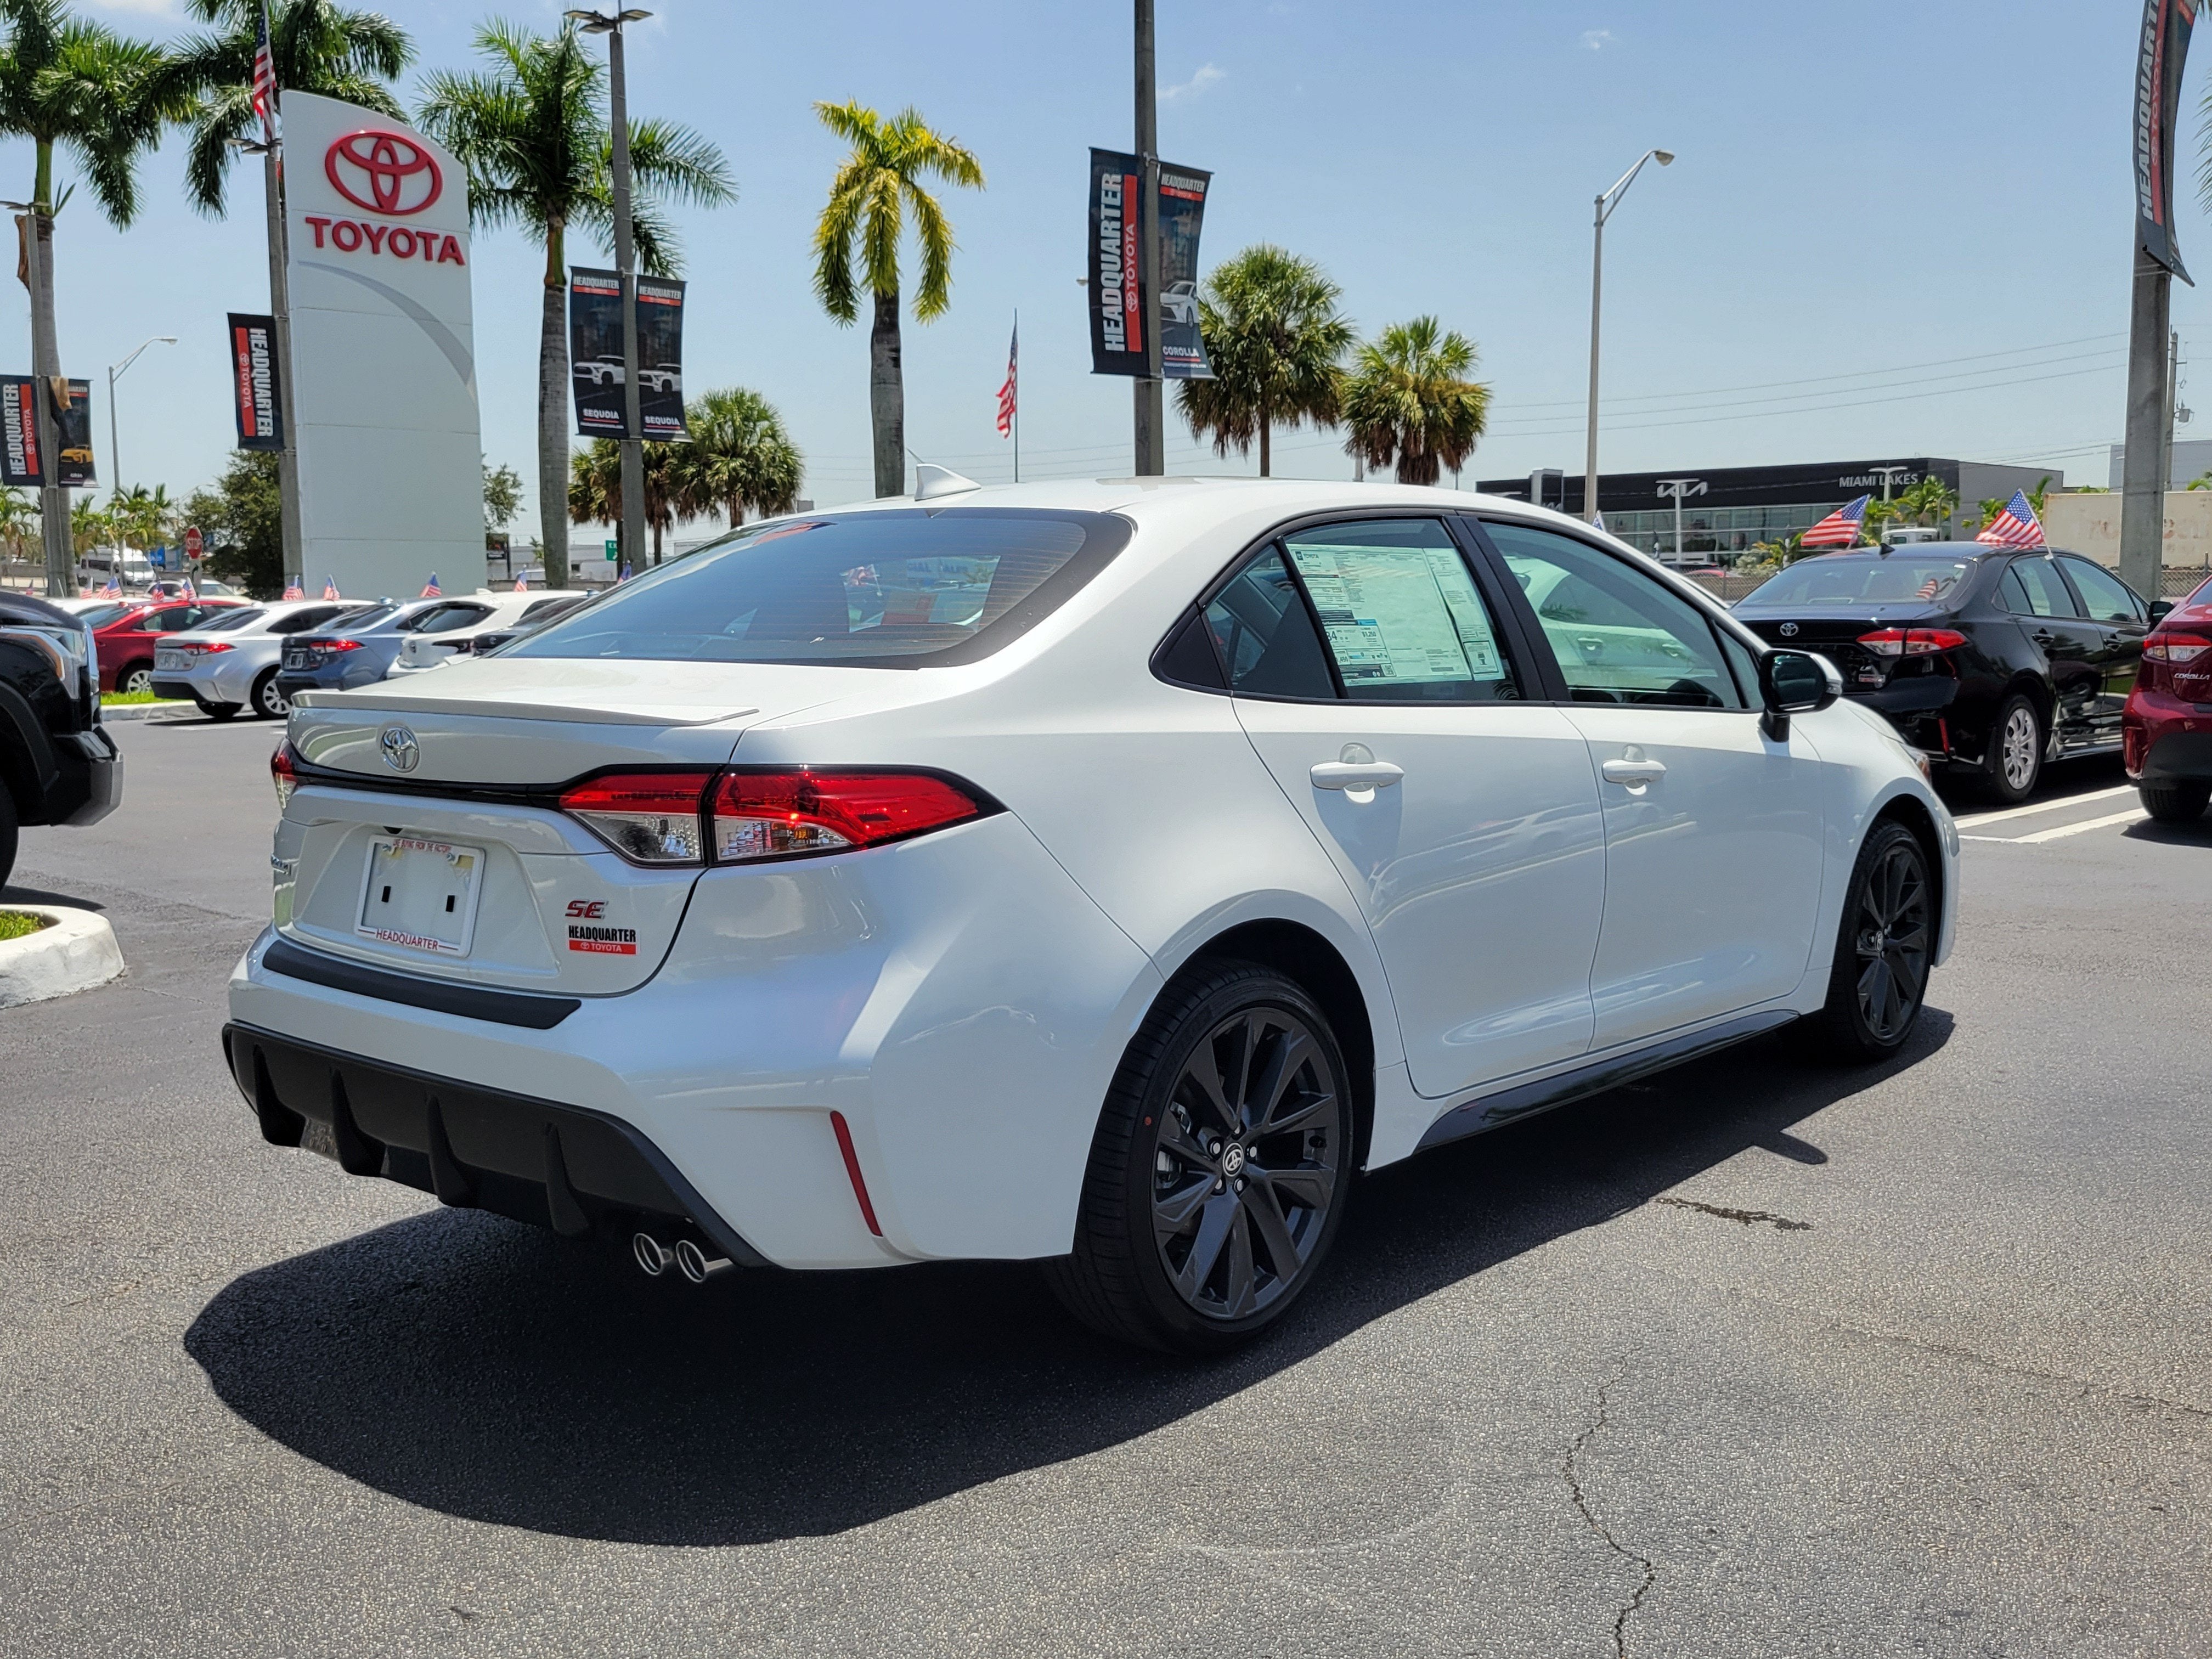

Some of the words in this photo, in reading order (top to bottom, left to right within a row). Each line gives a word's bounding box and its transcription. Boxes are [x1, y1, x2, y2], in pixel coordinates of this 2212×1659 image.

[2151, 38, 2162, 132] TOYOTA
[2138, 0, 2159, 221] HEADQUART
[1161, 173, 1205, 193] HEADQUARTER
[305, 217, 465, 266] TOYOTA
[1101, 173, 1125, 352] HEADQUARTER
[1126, 223, 1136, 289] TOYOTA
[574, 275, 619, 290] HEADQUARTER
[639, 285, 681, 300] HEADQUARTER
[1163, 345, 1199, 357] COROLLA
[241, 368, 252, 408] TOYOTA
[249, 328, 274, 437] HEADQUARTER
[583, 408, 619, 420] SEQUOIA
[645, 415, 681, 425] SEQUOIA
[3, 383, 27, 475] HEADQUARTER
[24, 409, 33, 441] TOYOTA
[1839, 475, 1877, 488] MIAMI
[1878, 473, 1919, 486] LAKES
[187, 538, 202, 549] STOP
[565, 899, 609, 919] SE
[376, 928, 438, 951] HEADQUARTER
[568, 924, 636, 943] HEADQUARTER
[591, 943, 623, 952] TOYOTA
